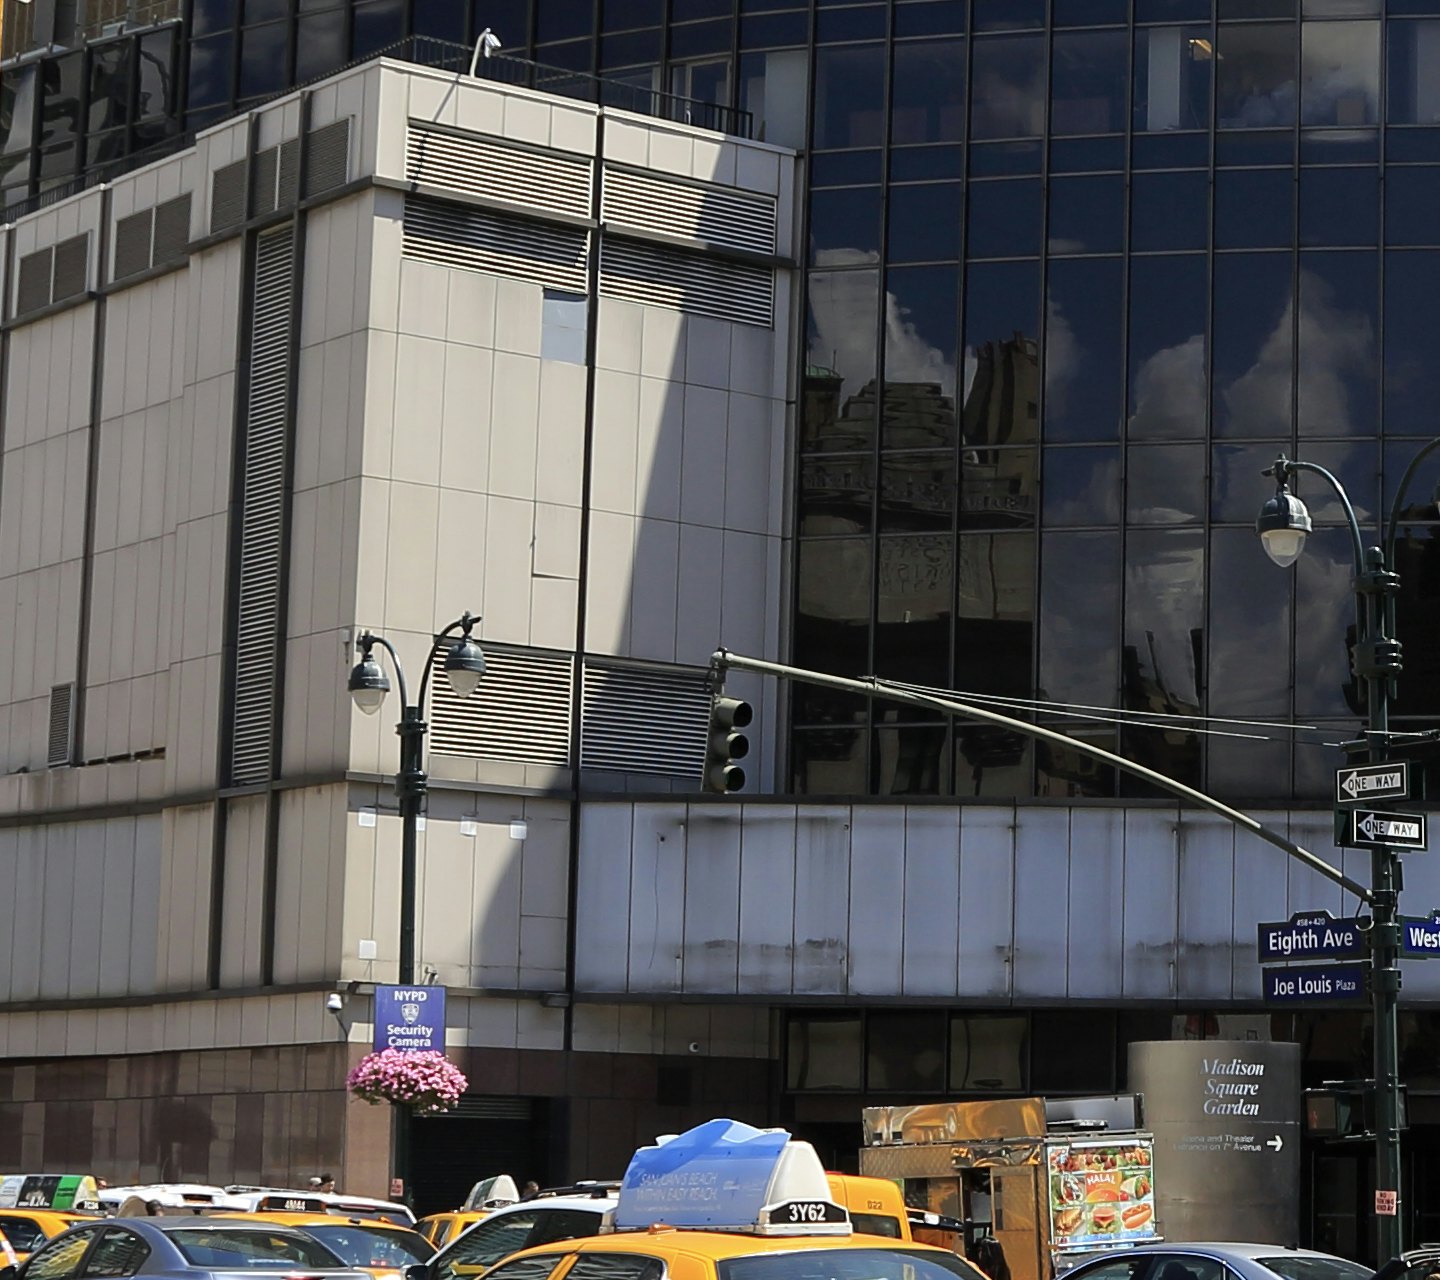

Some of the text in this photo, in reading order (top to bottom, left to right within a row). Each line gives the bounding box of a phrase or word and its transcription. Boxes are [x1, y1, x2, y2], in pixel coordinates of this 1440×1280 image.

[1348, 774, 1396, 791] ONE WAY
[1364, 821, 1414, 836] ONE WAY
[1269, 928, 1353, 955] Eighth Ave
[1273, 974, 1356, 996] Joe Louis Plaza
[394, 990, 427, 1001] NYPD
[387, 1024, 433, 1037] Security
[388, 1036, 431, 1047] Camera
[1200, 1058, 1265, 1076] Madison
[1204, 1079, 1259, 1098] Square
[1203, 1099, 1260, 1116] Garden
[1207, 1135, 1223, 1143] and
[1225, 1134, 1255, 1143] Theater
[1233, 1143, 1262, 1152] Avenue
[1086, 1173, 1116, 1186] HALAL
[788, 1204, 826, 1222] 3Y62
